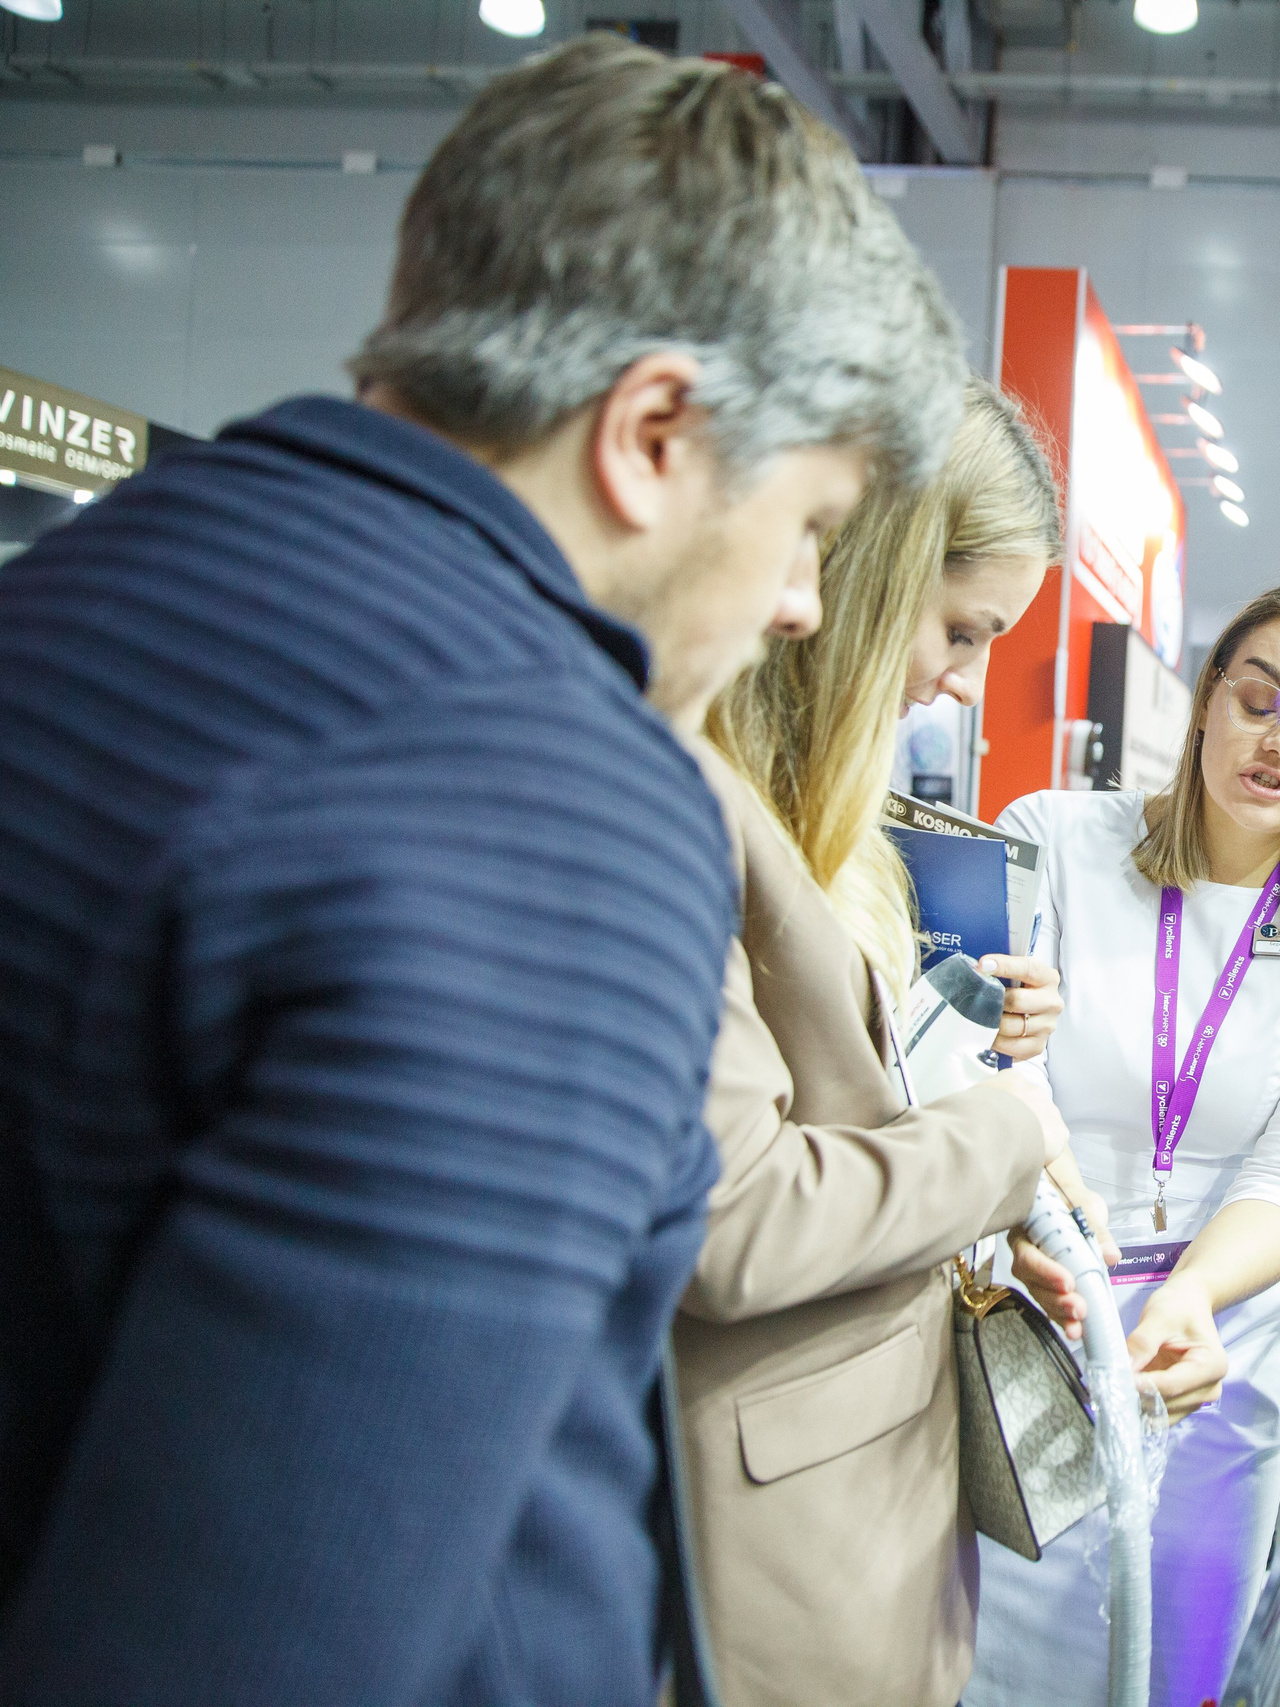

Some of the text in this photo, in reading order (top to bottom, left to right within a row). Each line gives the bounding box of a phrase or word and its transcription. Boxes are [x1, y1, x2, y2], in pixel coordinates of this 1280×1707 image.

[1164, 925, 1175, 959] yclients
[1226, 955, 1245, 988] yclients
[1164, 1114, 1181, 1151] yclients
